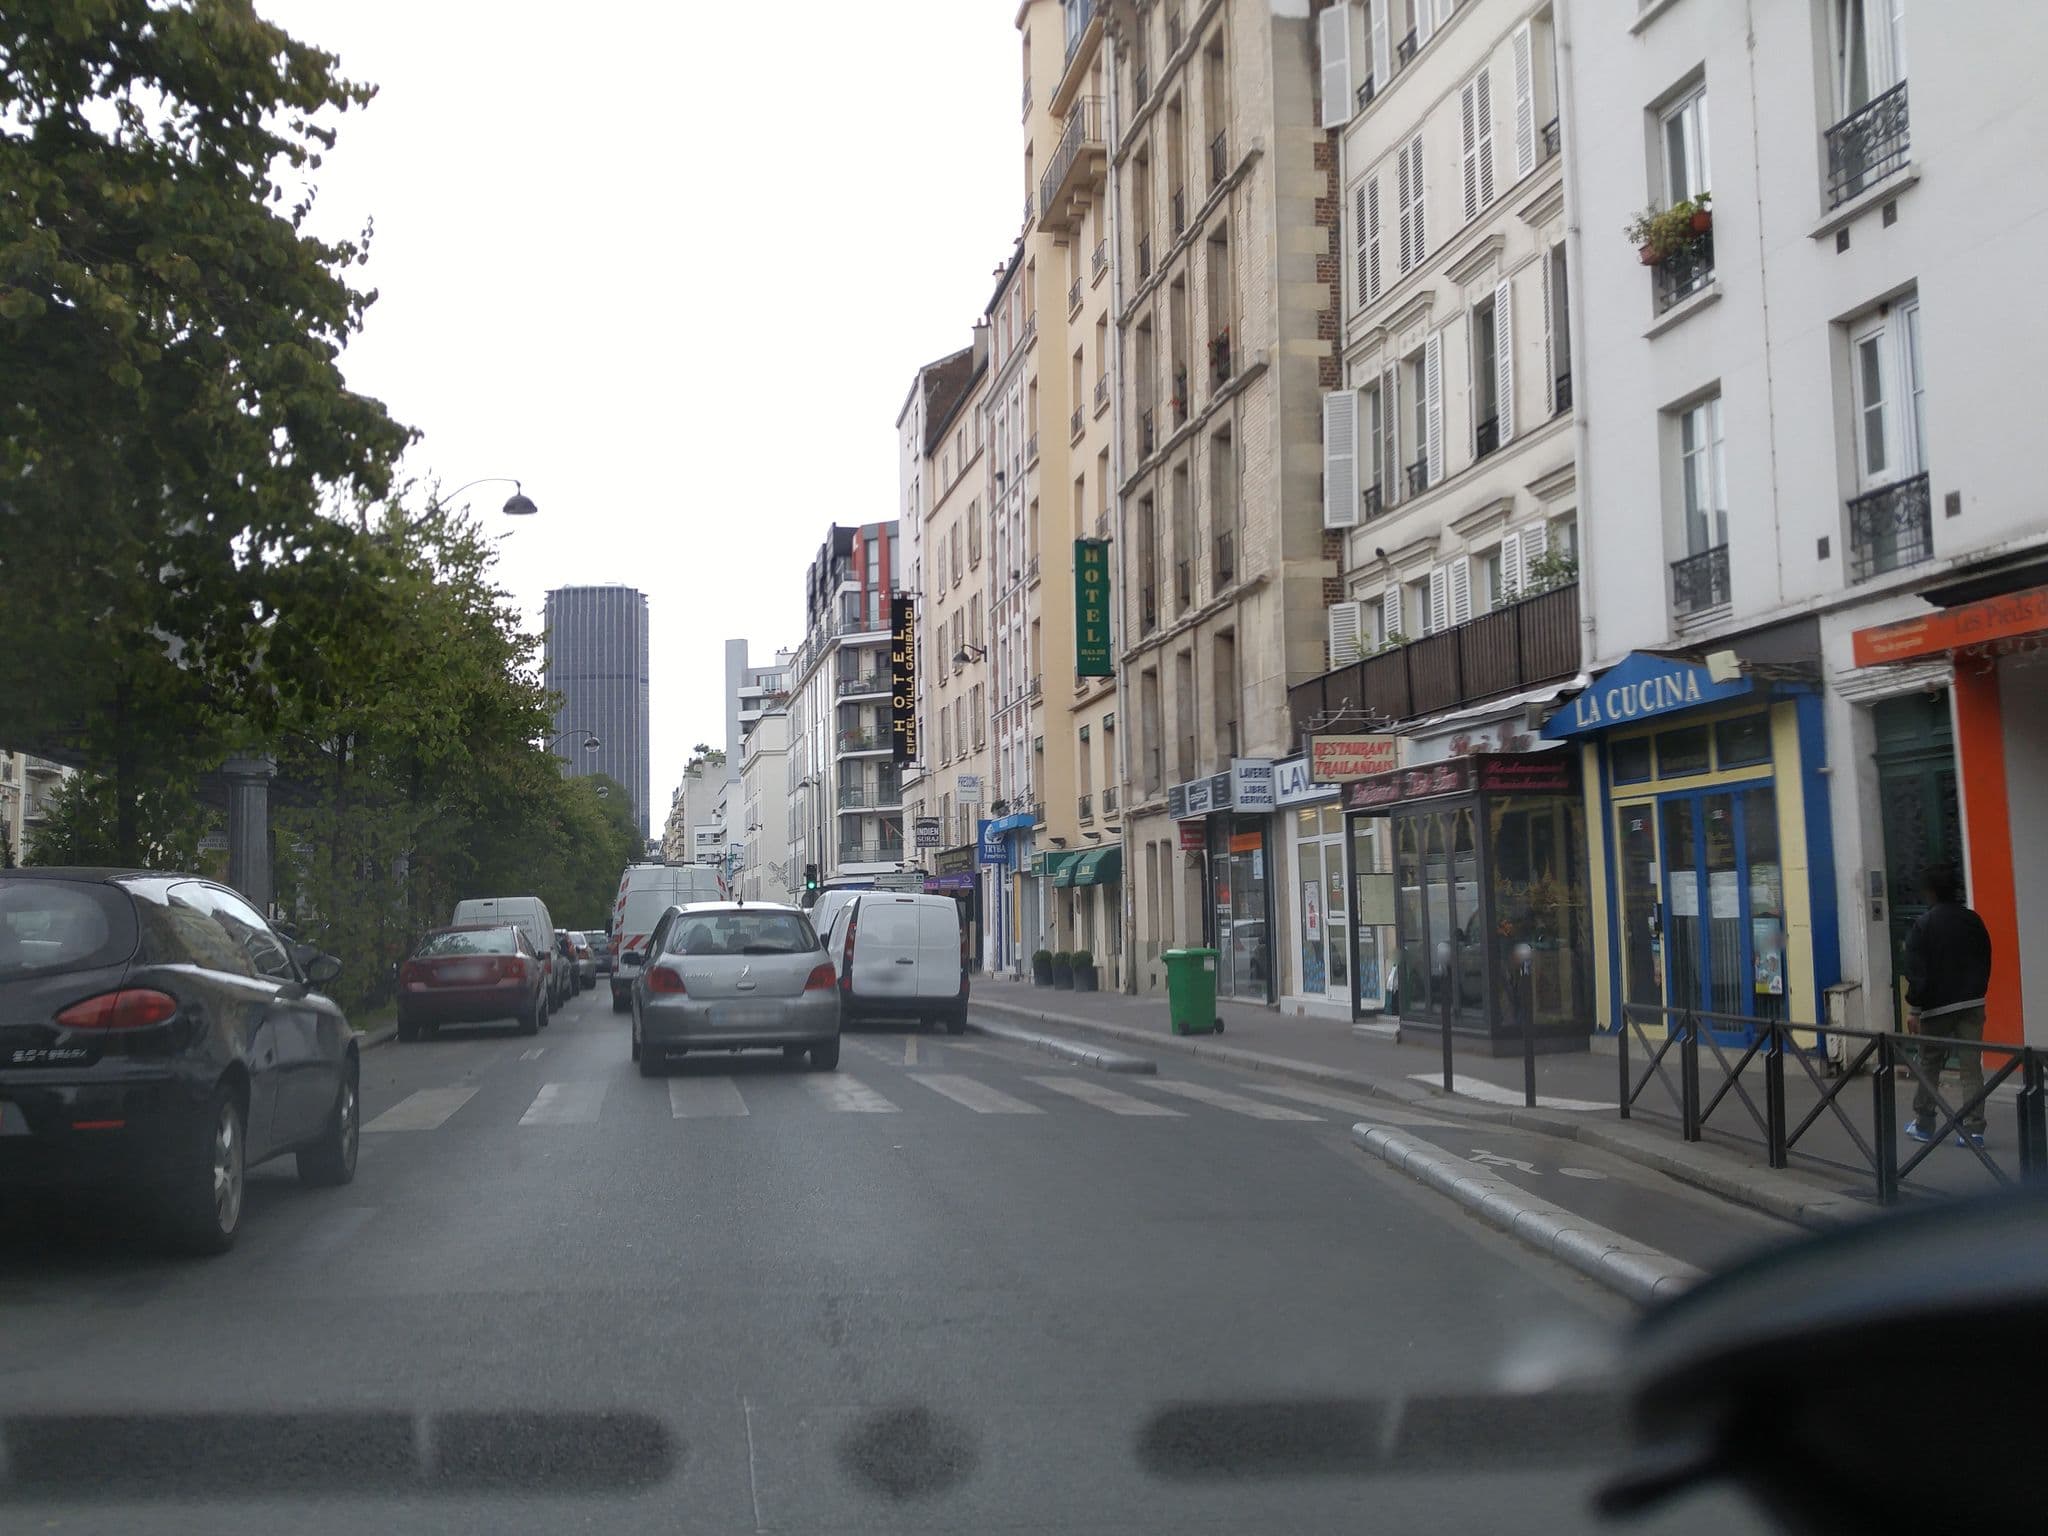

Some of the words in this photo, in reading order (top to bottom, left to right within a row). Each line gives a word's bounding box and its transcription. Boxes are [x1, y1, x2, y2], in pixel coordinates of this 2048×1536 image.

[1084, 548, 1100, 642] HOTEL
[904, 607, 914, 670] GARIBALDI
[893, 629, 906, 732] HOTEL
[906, 675, 915, 709] VILLA
[1575, 694, 1602, 728] LA
[1606, 669, 1702, 720] CUCINA
[906, 714, 916, 755] EIFFEL
[1314, 741, 1393, 760] RESTAURANT
[1239, 767, 1272, 779] LAVERIE
[1244, 785, 1268, 795] LIBRE
[1240, 795, 1274, 805] SERVICE
[916, 827, 939, 836] INDIEN
[917, 835, 939, 843] SURAJ
[983, 844, 1007, 853] TRYBA
